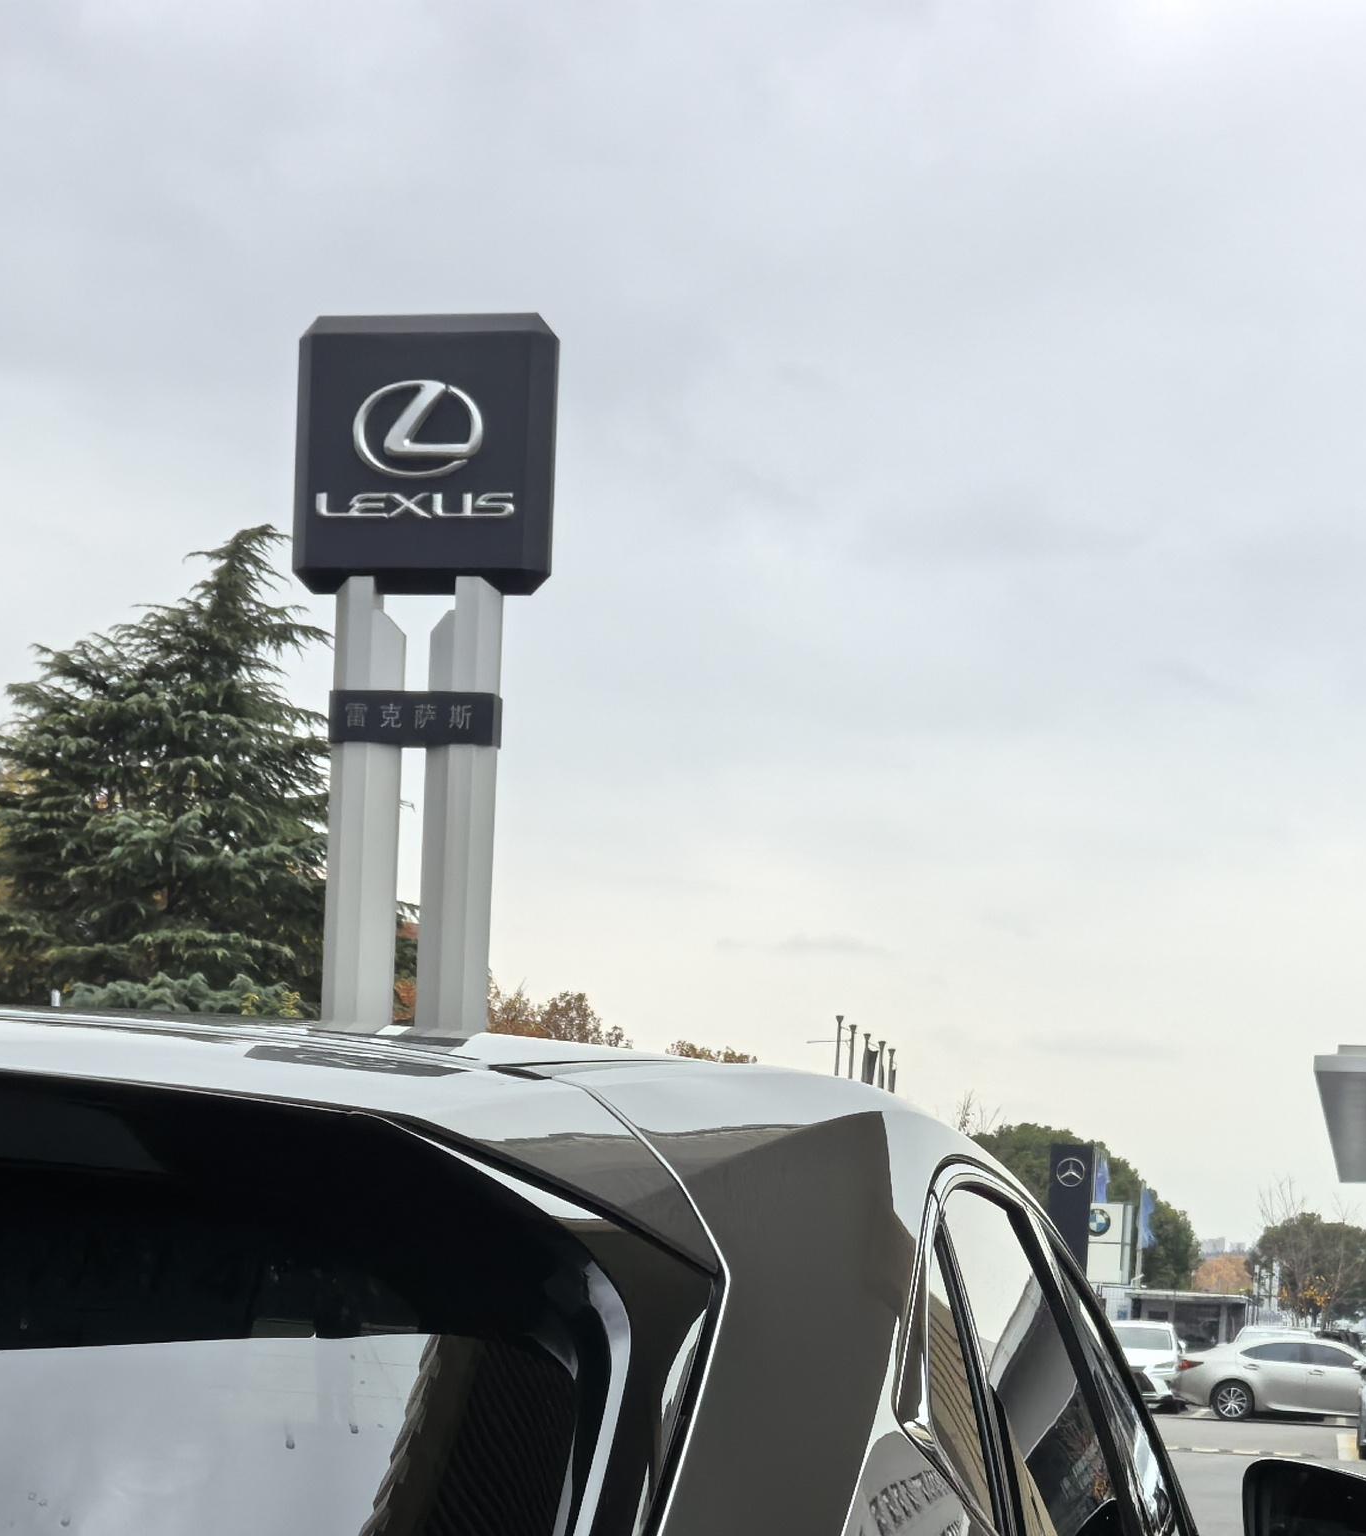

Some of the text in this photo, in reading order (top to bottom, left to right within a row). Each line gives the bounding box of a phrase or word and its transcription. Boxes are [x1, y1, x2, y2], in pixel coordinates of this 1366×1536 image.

[315, 491, 515, 519] LEXUS
[345, 702, 472, 730] 雷克萨斯
